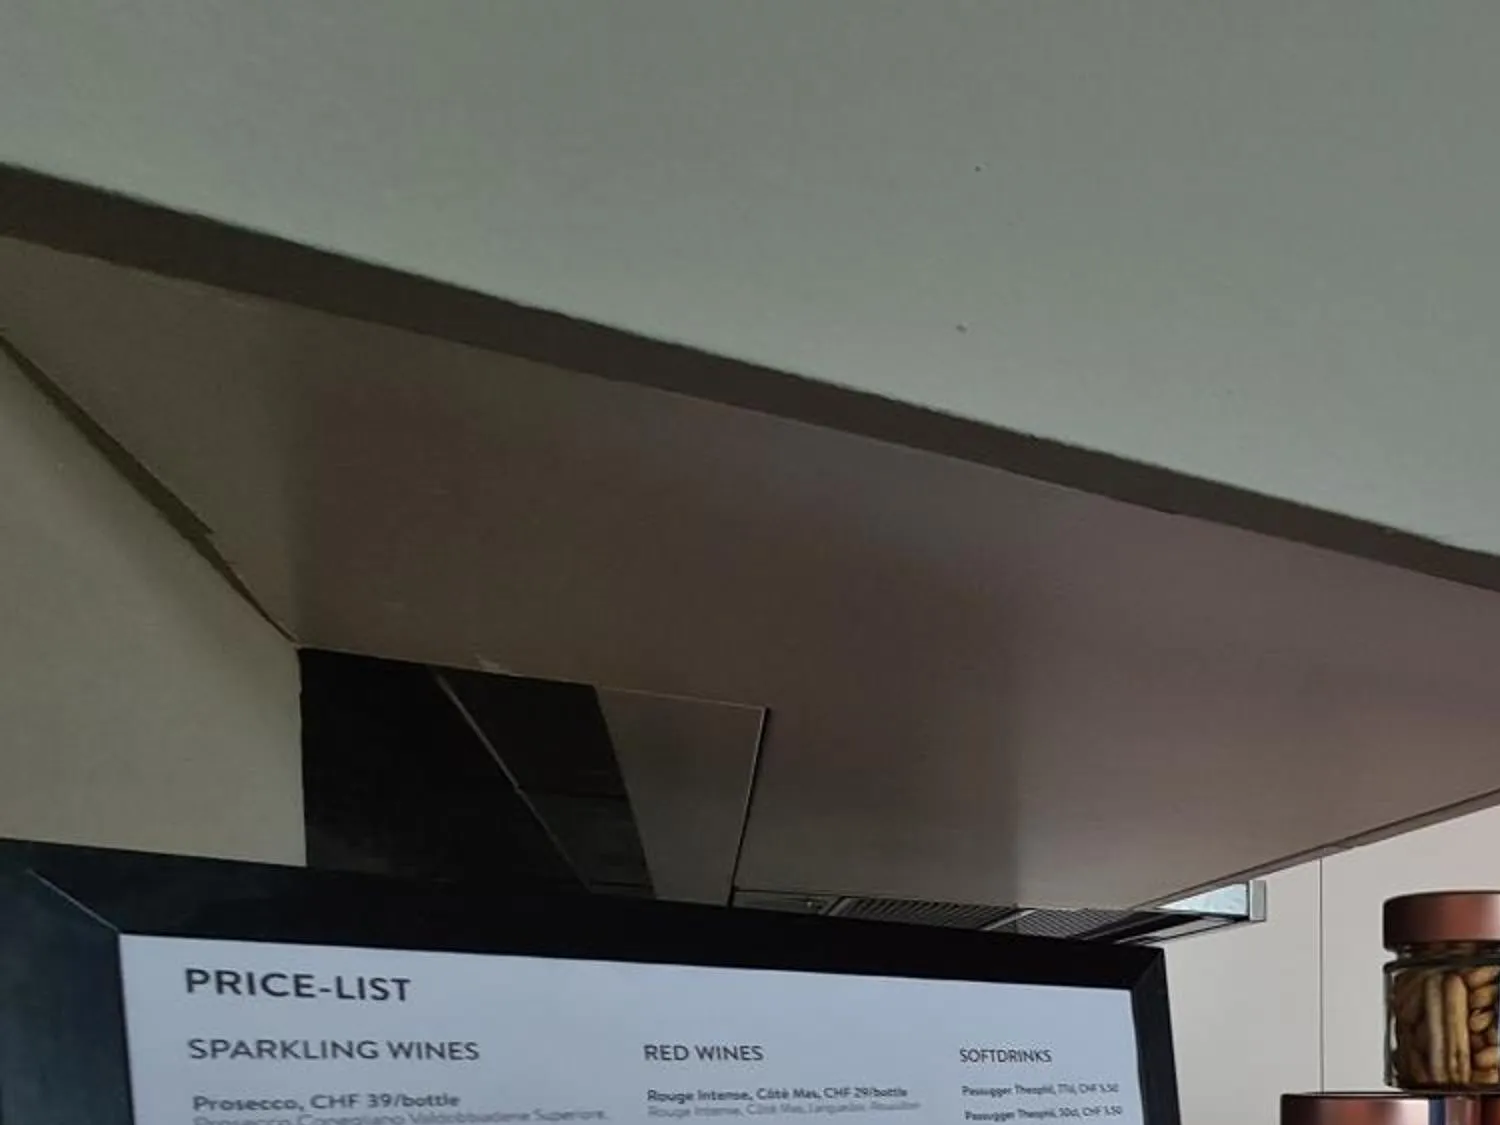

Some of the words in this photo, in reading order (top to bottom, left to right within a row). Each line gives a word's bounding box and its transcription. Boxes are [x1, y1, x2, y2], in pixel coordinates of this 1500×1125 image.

[184, 968, 411, 1001] PRICE-LIST
[188, 1039, 379, 1061] SPARKLING
[387, 1041, 480, 1061] WINES
[644, 1044, 689, 1061] RED
[694, 1045, 764, 1061] WINES
[959, 1048, 1052, 1063] SOFTDRINKS
[647, 1089, 693, 1104] Rouge
[697, 1089, 753, 1101] Intense,
[823, 1087, 851, 1098] CHF
[1079, 1082, 1097, 1094] CHF
[193, 1096, 304, 1112] Prosecco,
[310, 1093, 361, 1109] CHF
[367, 1092, 460, 1109] 39/bottle
[1082, 1105, 1102, 1117] CHF
